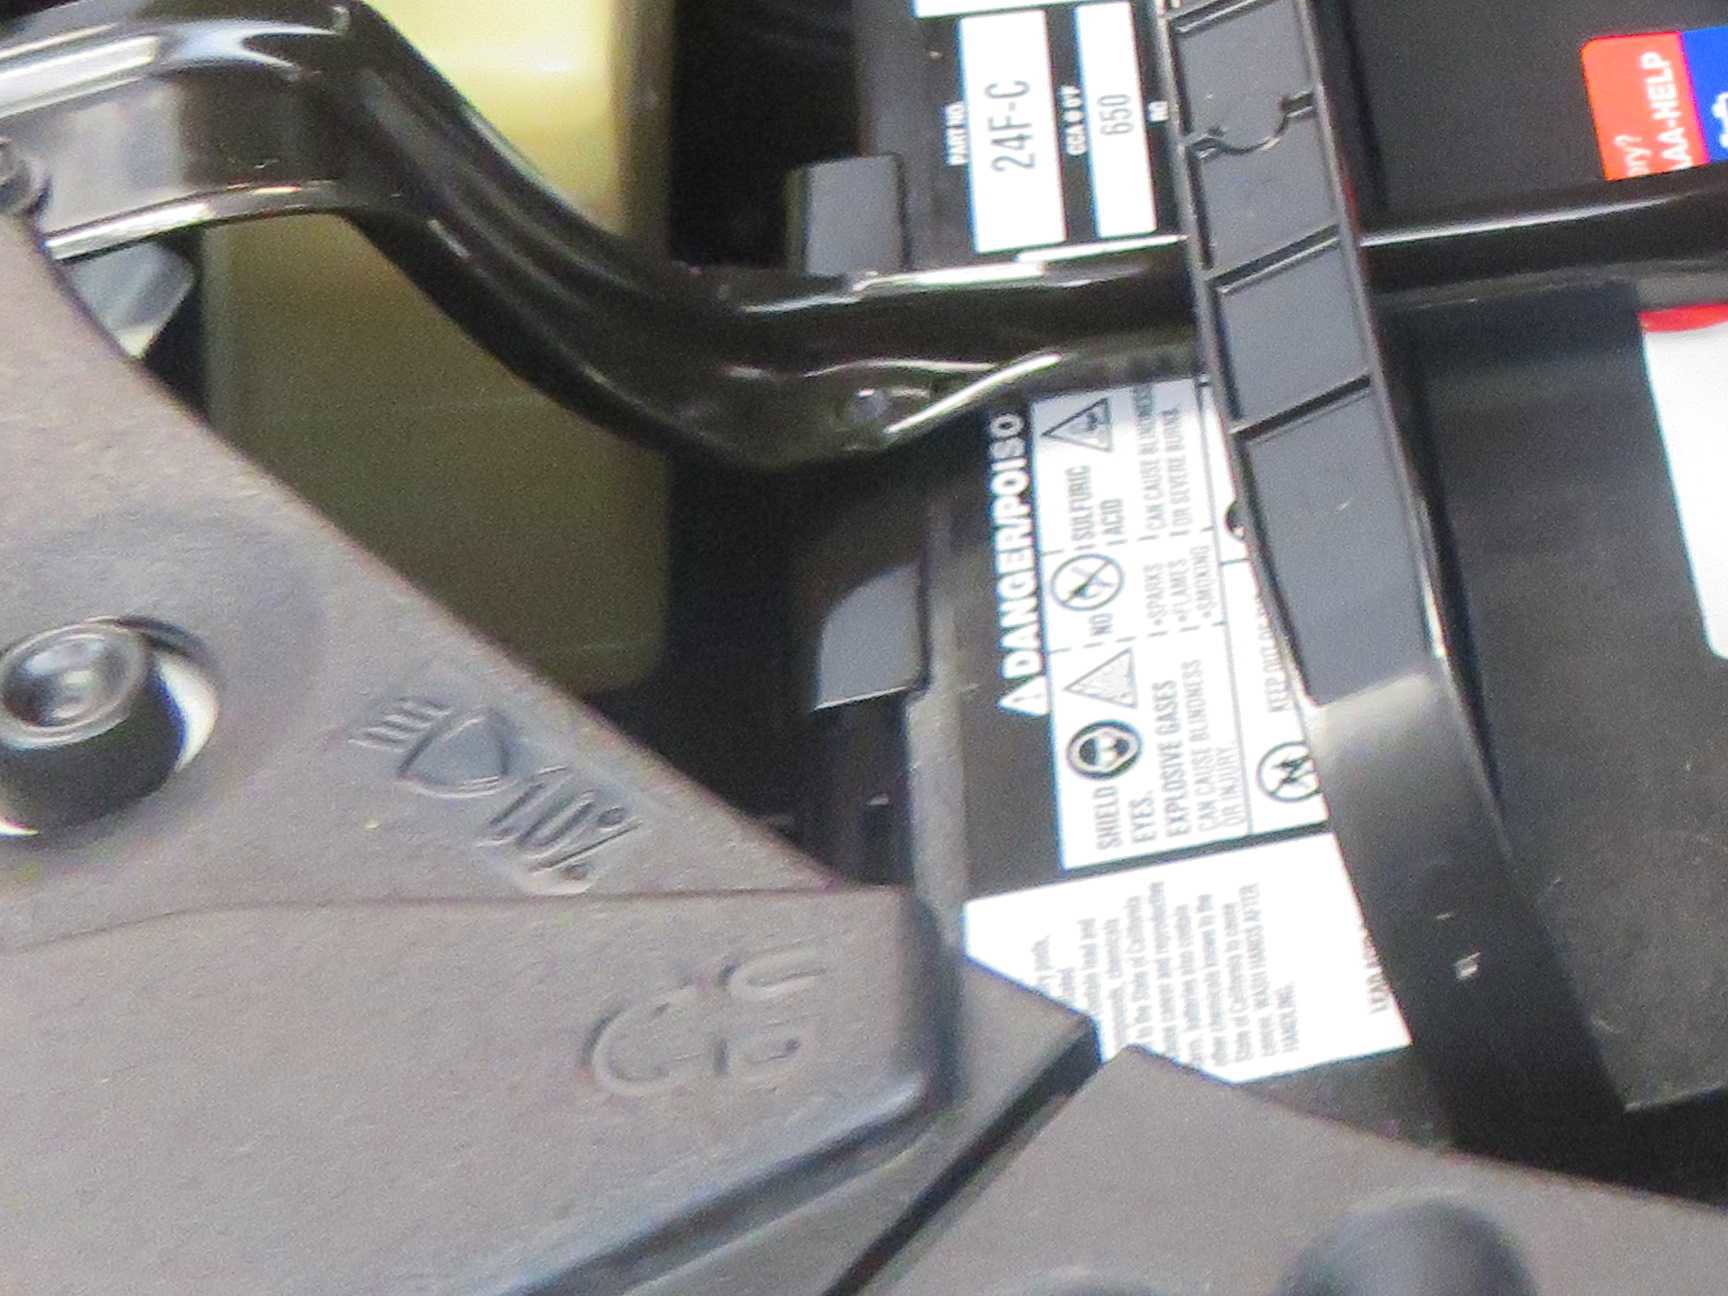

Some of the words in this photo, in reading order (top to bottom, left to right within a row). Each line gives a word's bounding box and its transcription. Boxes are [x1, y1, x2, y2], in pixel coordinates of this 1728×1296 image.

[984, 79, 1037, 173] 24F-C
[1098, 93, 1134, 138] 650
[1138, 458, 1164, 501] CAUSE
[1165, 454, 1190, 505] SEVERE
[1065, 463, 1095, 542] SULFURIC
[1099, 497, 1125, 537] ACID
[1142, 501, 1166, 531] CAN
[1170, 504, 1191, 526] OR
[1190, 543, 1216, 611] SMOKING
[1087, 611, 1114, 637] NO
[1151, 677, 1181, 736] GASES
[1180, 657, 1209, 743] BLINDNESS
[1261, 678, 1293, 712] KEEP
[1156, 738, 1190, 839] EXPLOSIVE
[1189, 742, 1216, 796] CAUSE
[1091, 783, 1123, 851] SHIELD
[1127, 788, 1158, 845] EYES.
[1195, 796, 1220, 832] CAN
[1220, 801, 1245, 828] OR
[1122, 894, 1145, 955] California
[1238, 881, 1263, 924] AFTER
[1244, 924, 1267, 970] HANDS
[1129, 970, 1150, 1003] State
[1223, 953, 1247, 1013] California
[1250, 970, 1271, 1009] WASH
[1232, 1029, 1253, 1063] State
